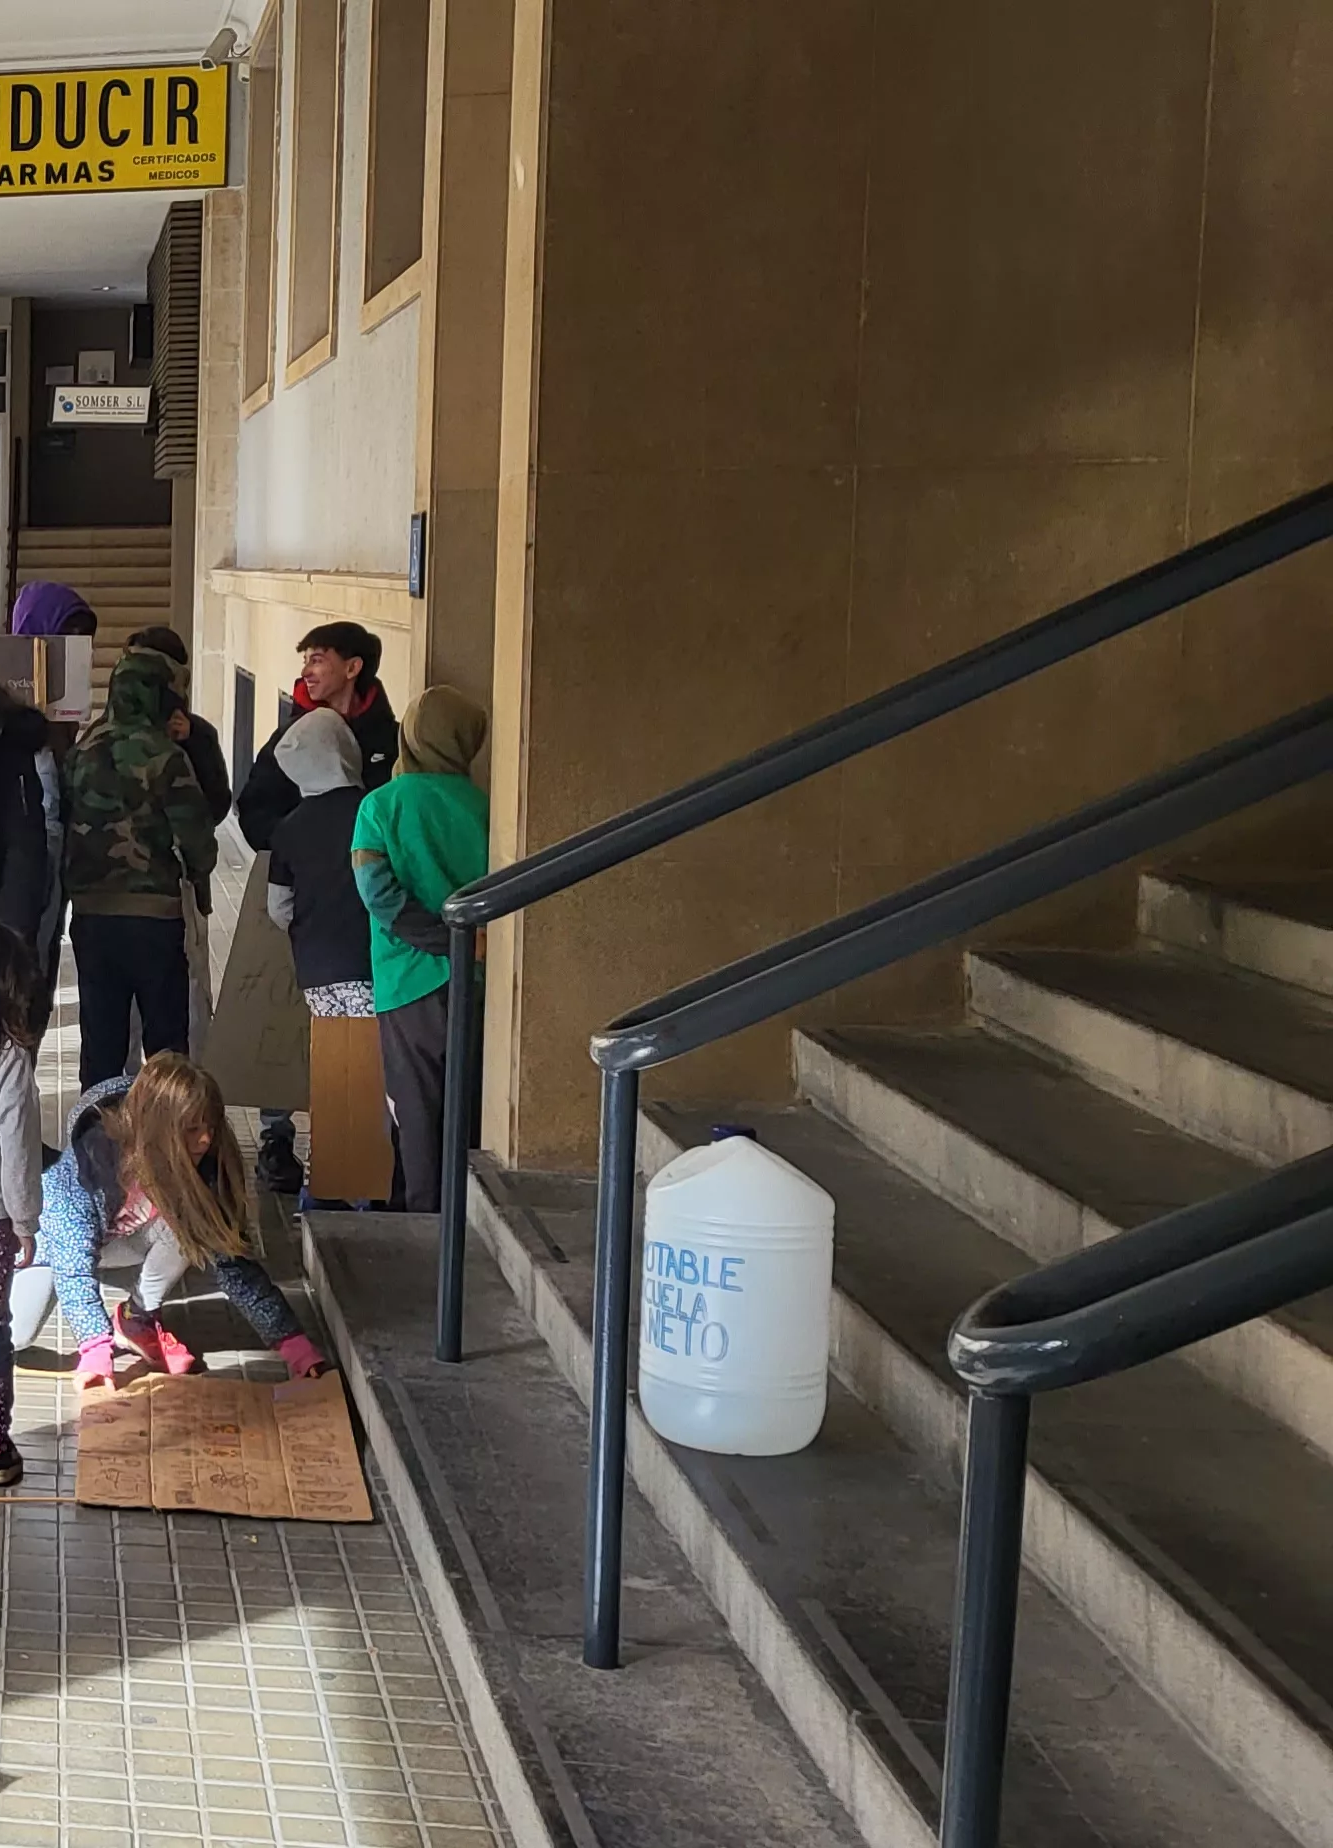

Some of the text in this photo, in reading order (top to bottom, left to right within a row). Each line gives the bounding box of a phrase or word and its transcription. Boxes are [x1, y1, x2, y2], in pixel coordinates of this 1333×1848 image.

[132, 151, 217, 165] CERTIFICADOS
[148, 168, 201, 181] MEDICOS
[76, 395, 146, 408] SOMSER S.L.
